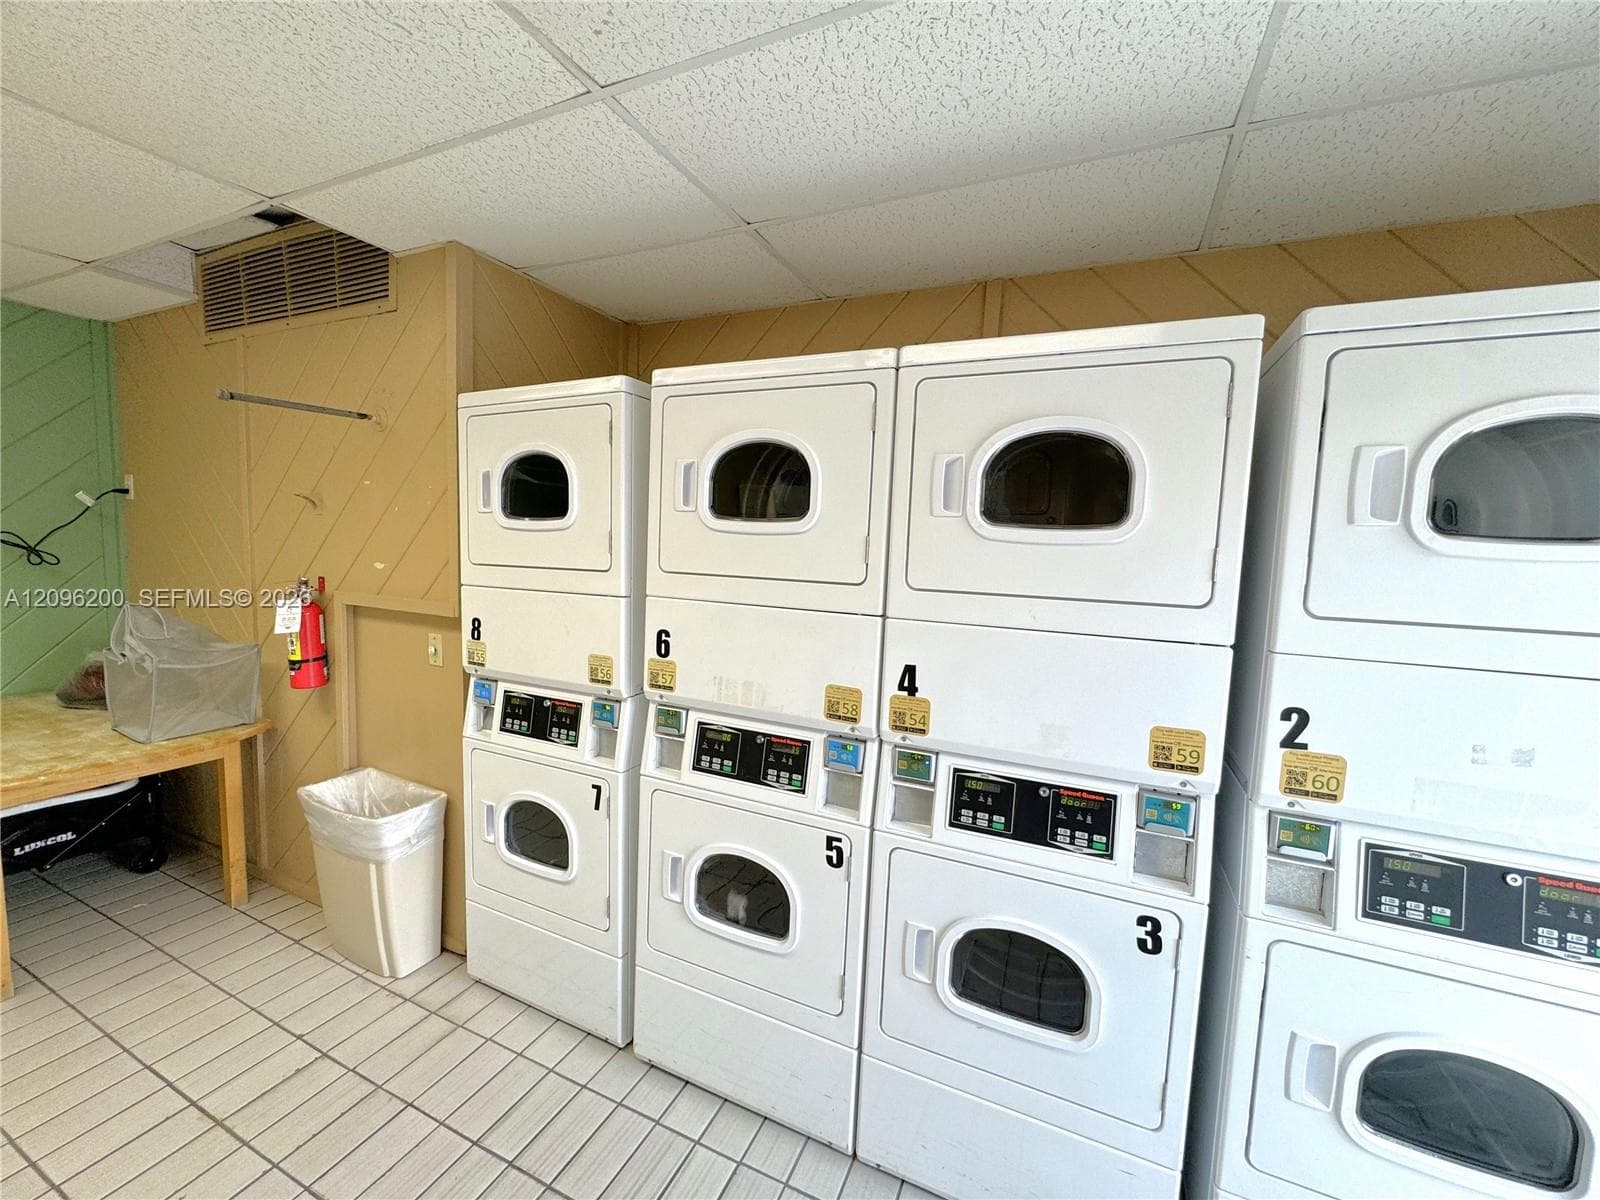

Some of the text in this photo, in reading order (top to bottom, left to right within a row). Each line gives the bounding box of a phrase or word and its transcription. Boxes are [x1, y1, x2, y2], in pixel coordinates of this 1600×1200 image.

[471, 617, 481, 641] 8
[656, 629, 671, 658] 6
[475, 652, 485, 662] 55
[600, 668, 611, 679] 56
[661, 673, 674, 685] 57
[897, 664, 919, 697] 4
[842, 703, 858, 716] 58
[909, 713, 927, 727] 54
[1279, 706, 1311, 750] 2
[1175, 748, 1200, 765] 59
[1312, 774, 1340, 792] 60
[591, 784, 602, 811] 7
[1059, 788, 1105, 801] Speed Queen
[13, 831, 77, 857] LUXCOL
[825, 835, 844, 869] 5
[1537, 876, 1574, 889] Speed
[1136, 914, 1163, 956] 3
